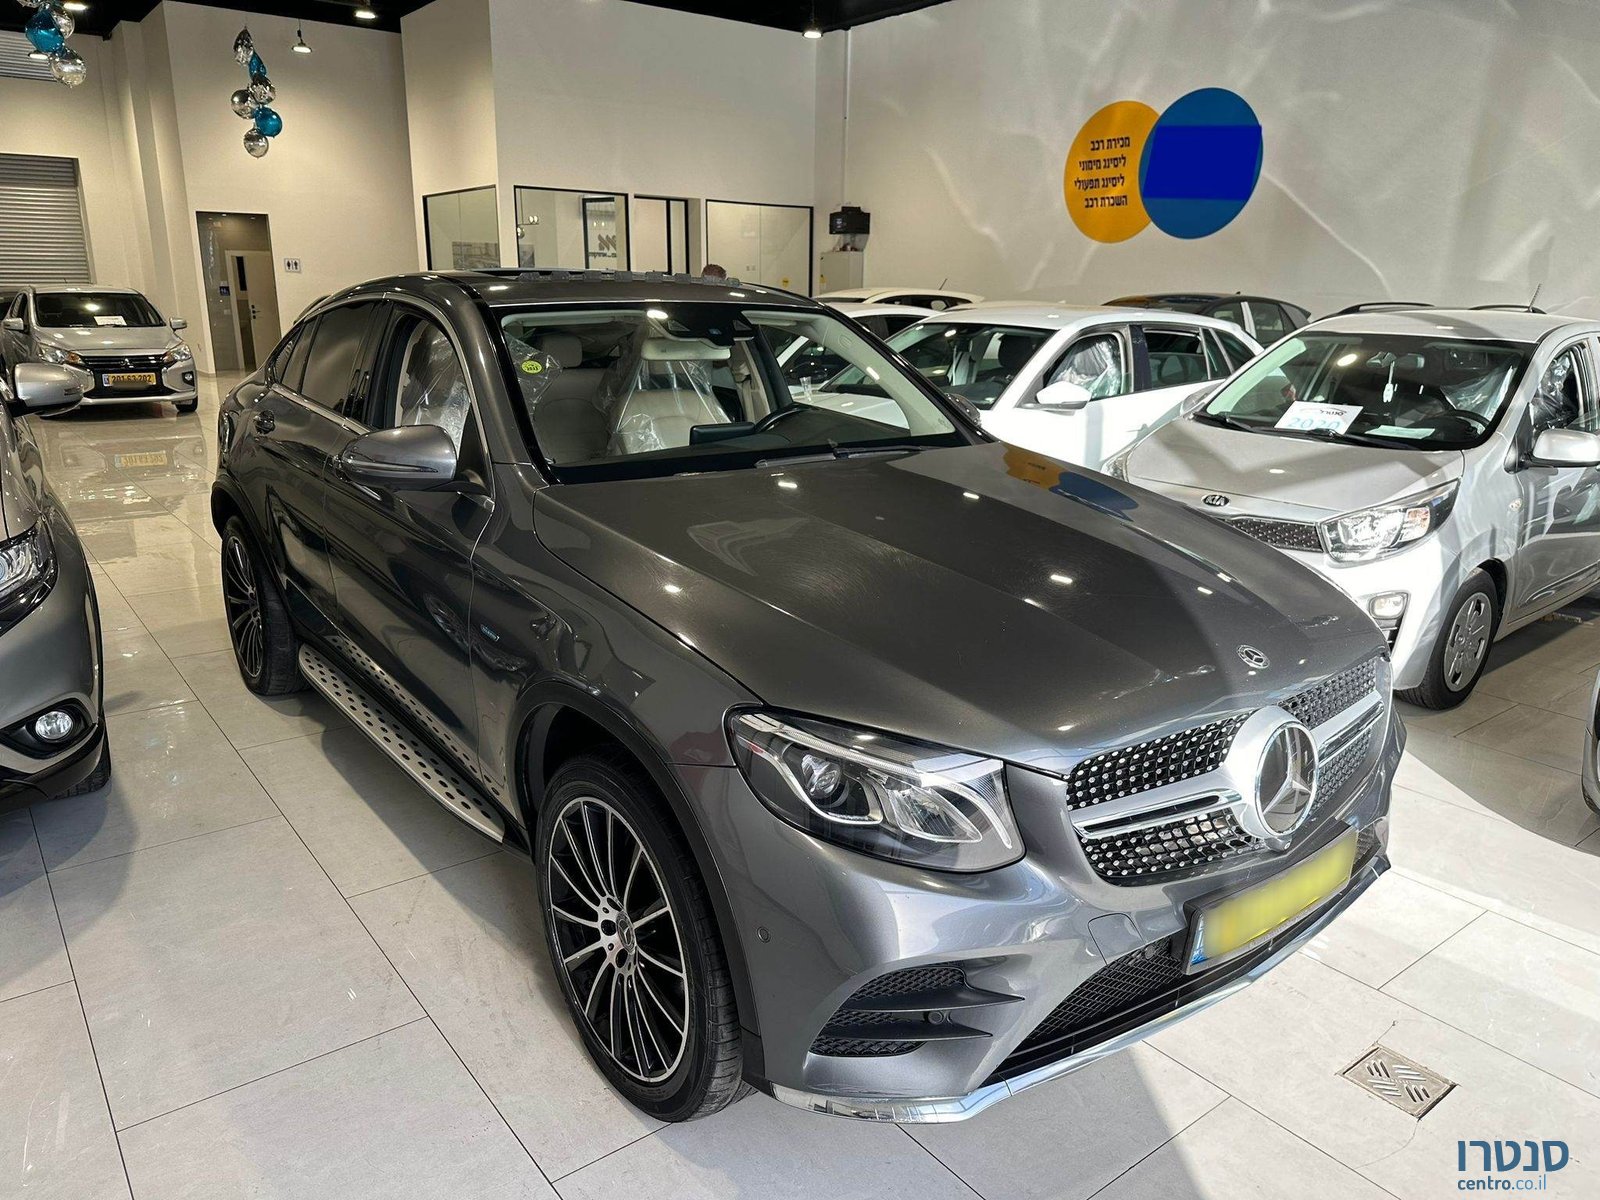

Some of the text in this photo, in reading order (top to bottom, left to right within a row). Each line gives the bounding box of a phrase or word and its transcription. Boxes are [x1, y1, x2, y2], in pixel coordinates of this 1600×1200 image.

[1091, 137, 1130, 151] מכירת רכב
[1079, 154, 1126, 171] ליסינג מימוני
[1074, 174, 1125, 191] ליסינג תפעולי
[1085, 195, 1128, 208] השכרת רכב
[1205, 495, 1228, 506] KIA
